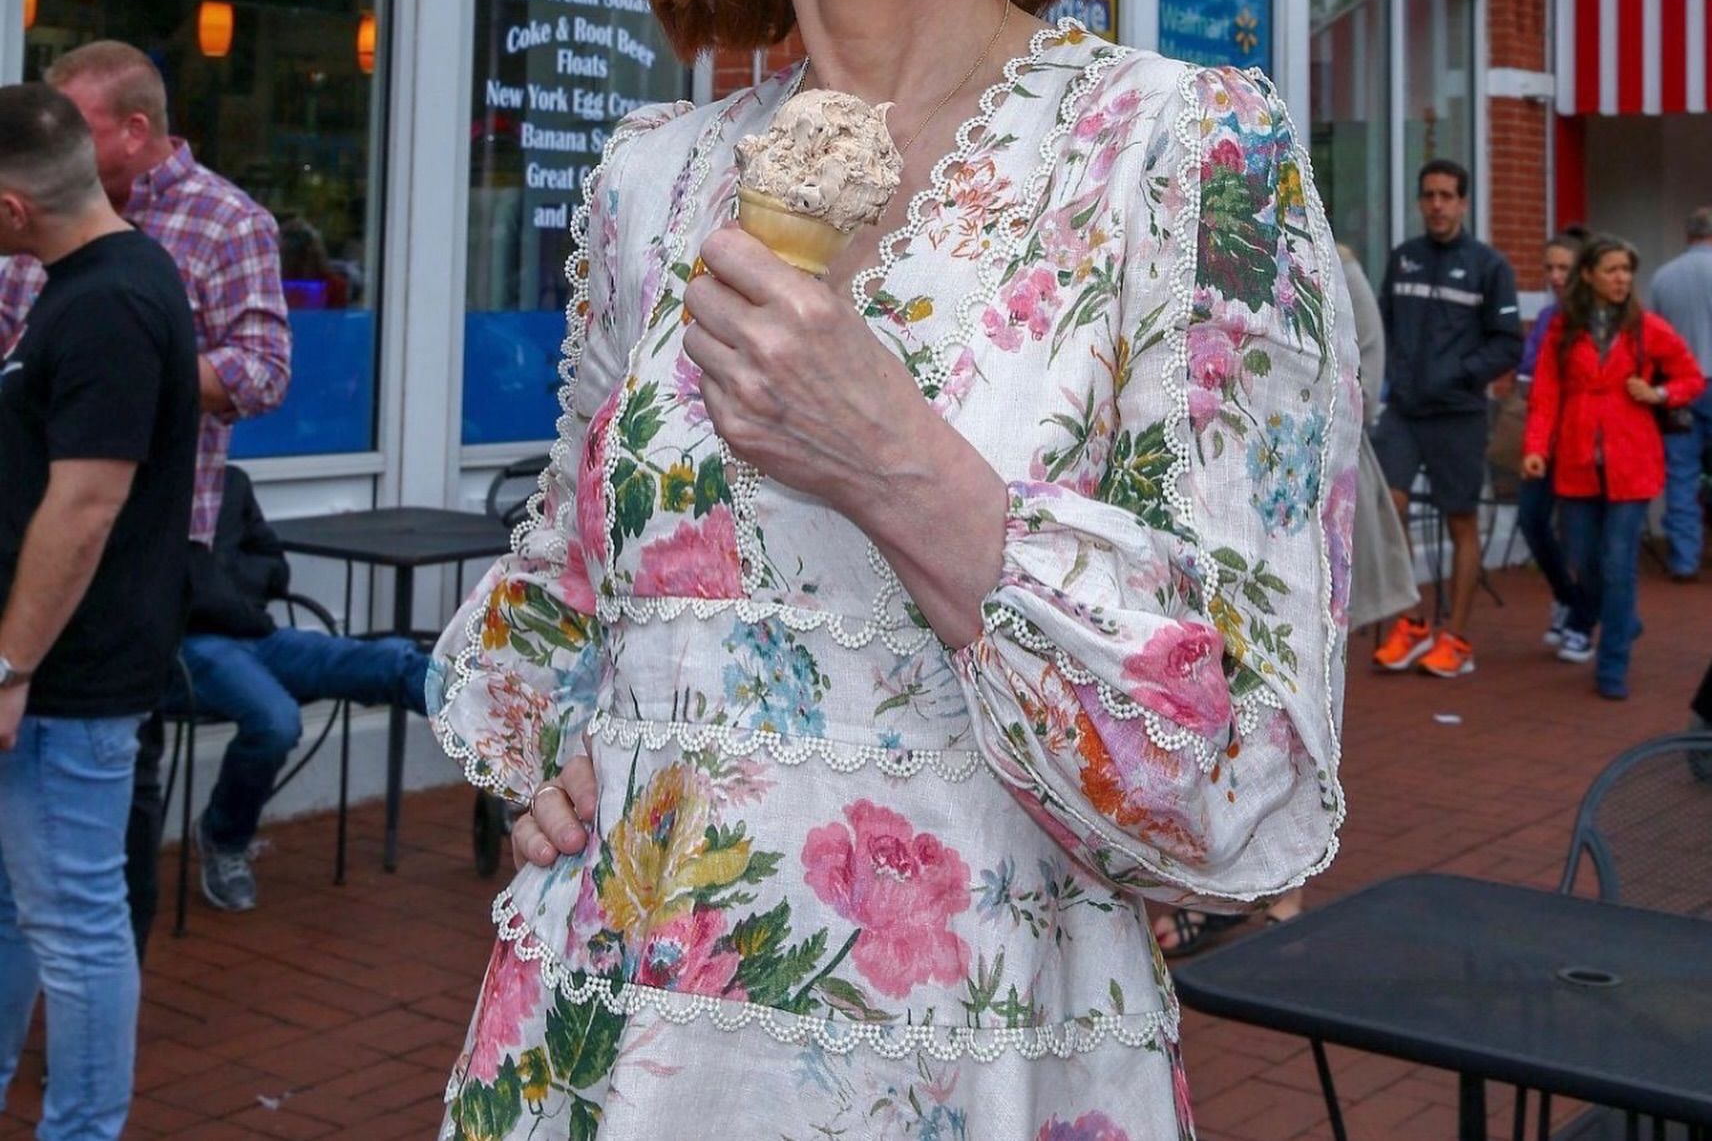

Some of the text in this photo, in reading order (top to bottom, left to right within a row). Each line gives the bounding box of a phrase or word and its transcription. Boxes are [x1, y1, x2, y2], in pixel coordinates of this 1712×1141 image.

[506, 15, 656, 69] Coke & Root Beer
[557, 48, 608, 79] Floats
[485, 79, 524, 108] New
[527, 83, 568, 112] York
[572, 88, 605, 121] Egg
[521, 123, 587, 153] Banana
[526, 162, 574, 190] Great
[533, 202, 568, 229] and
